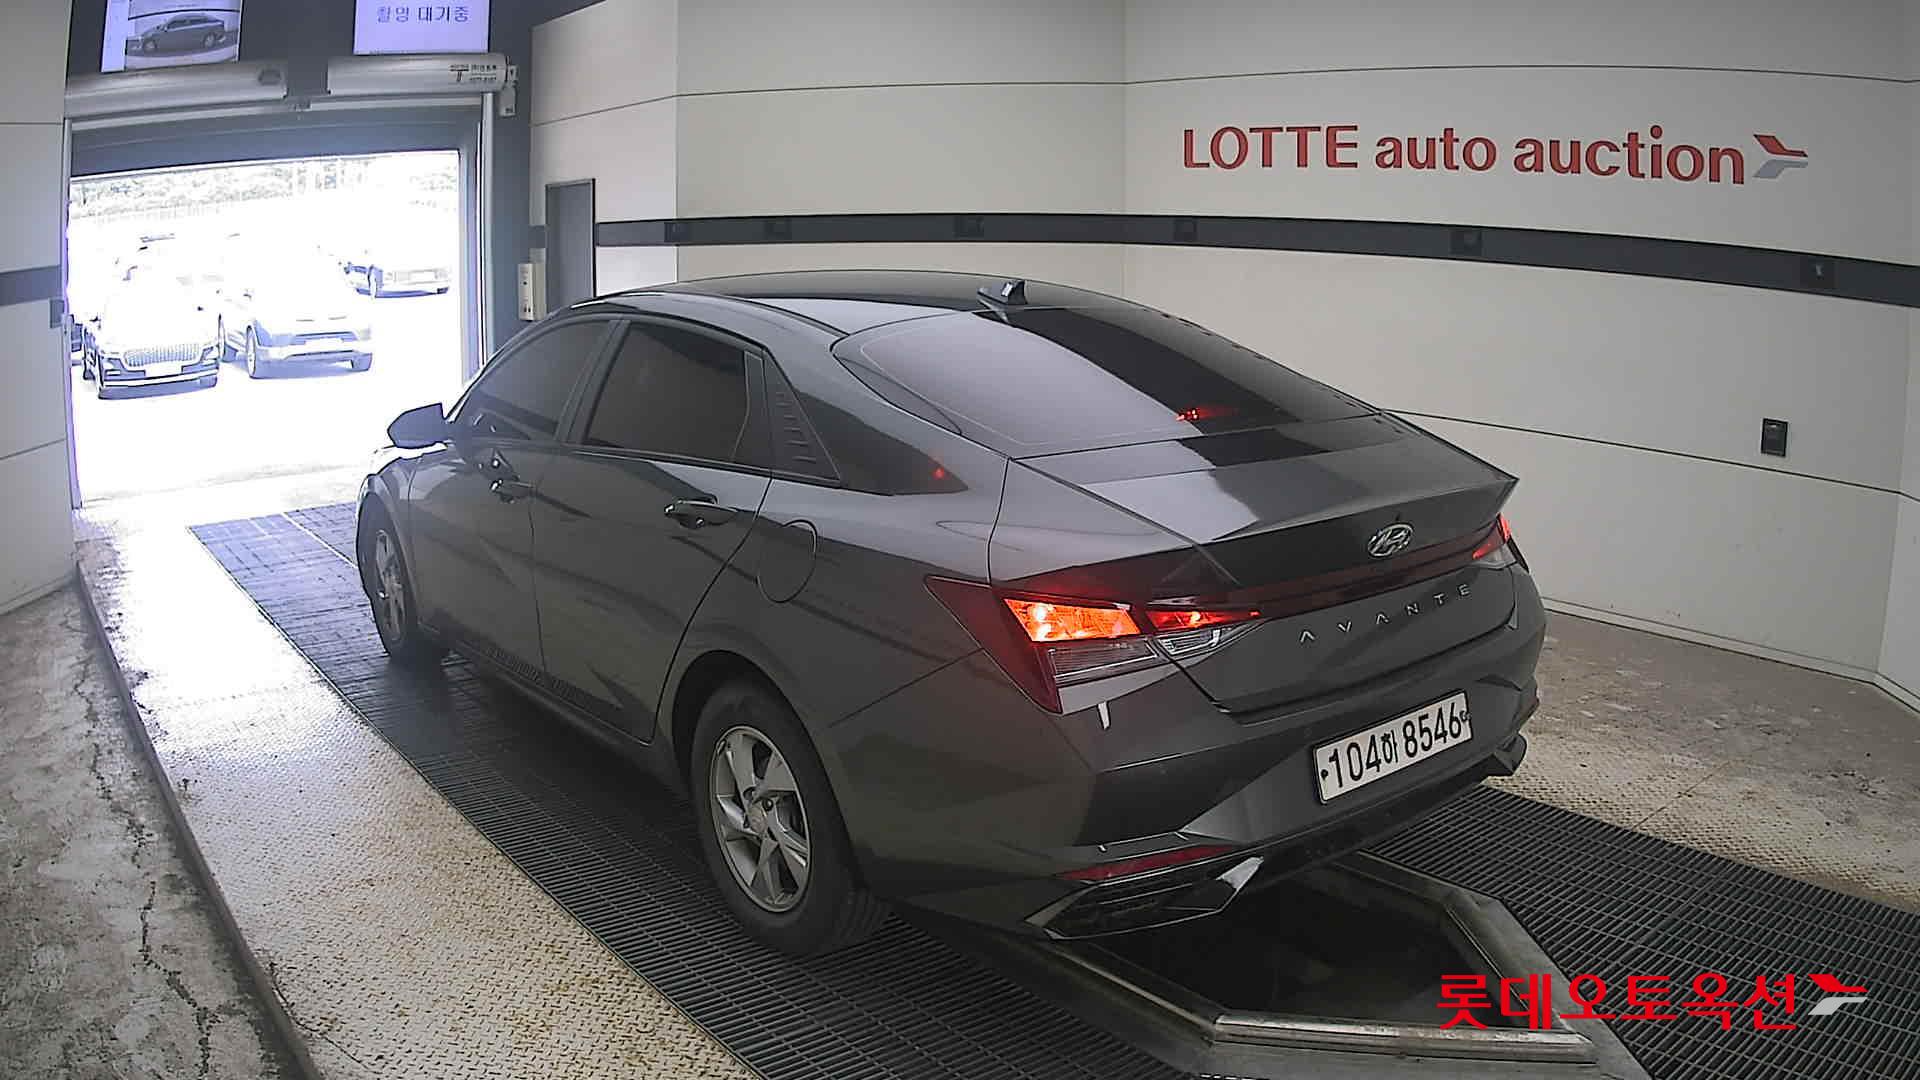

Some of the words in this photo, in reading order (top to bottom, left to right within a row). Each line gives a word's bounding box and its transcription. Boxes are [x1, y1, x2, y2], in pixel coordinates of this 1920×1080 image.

[418, 5, 469, 23] 대기중
[1184, 126, 1358, 169] LOTTE
[1375, 128, 1497, 170] auto
[1513, 126, 1744, 184] auction
[1300, 584, 1472, 643] AVANTE
